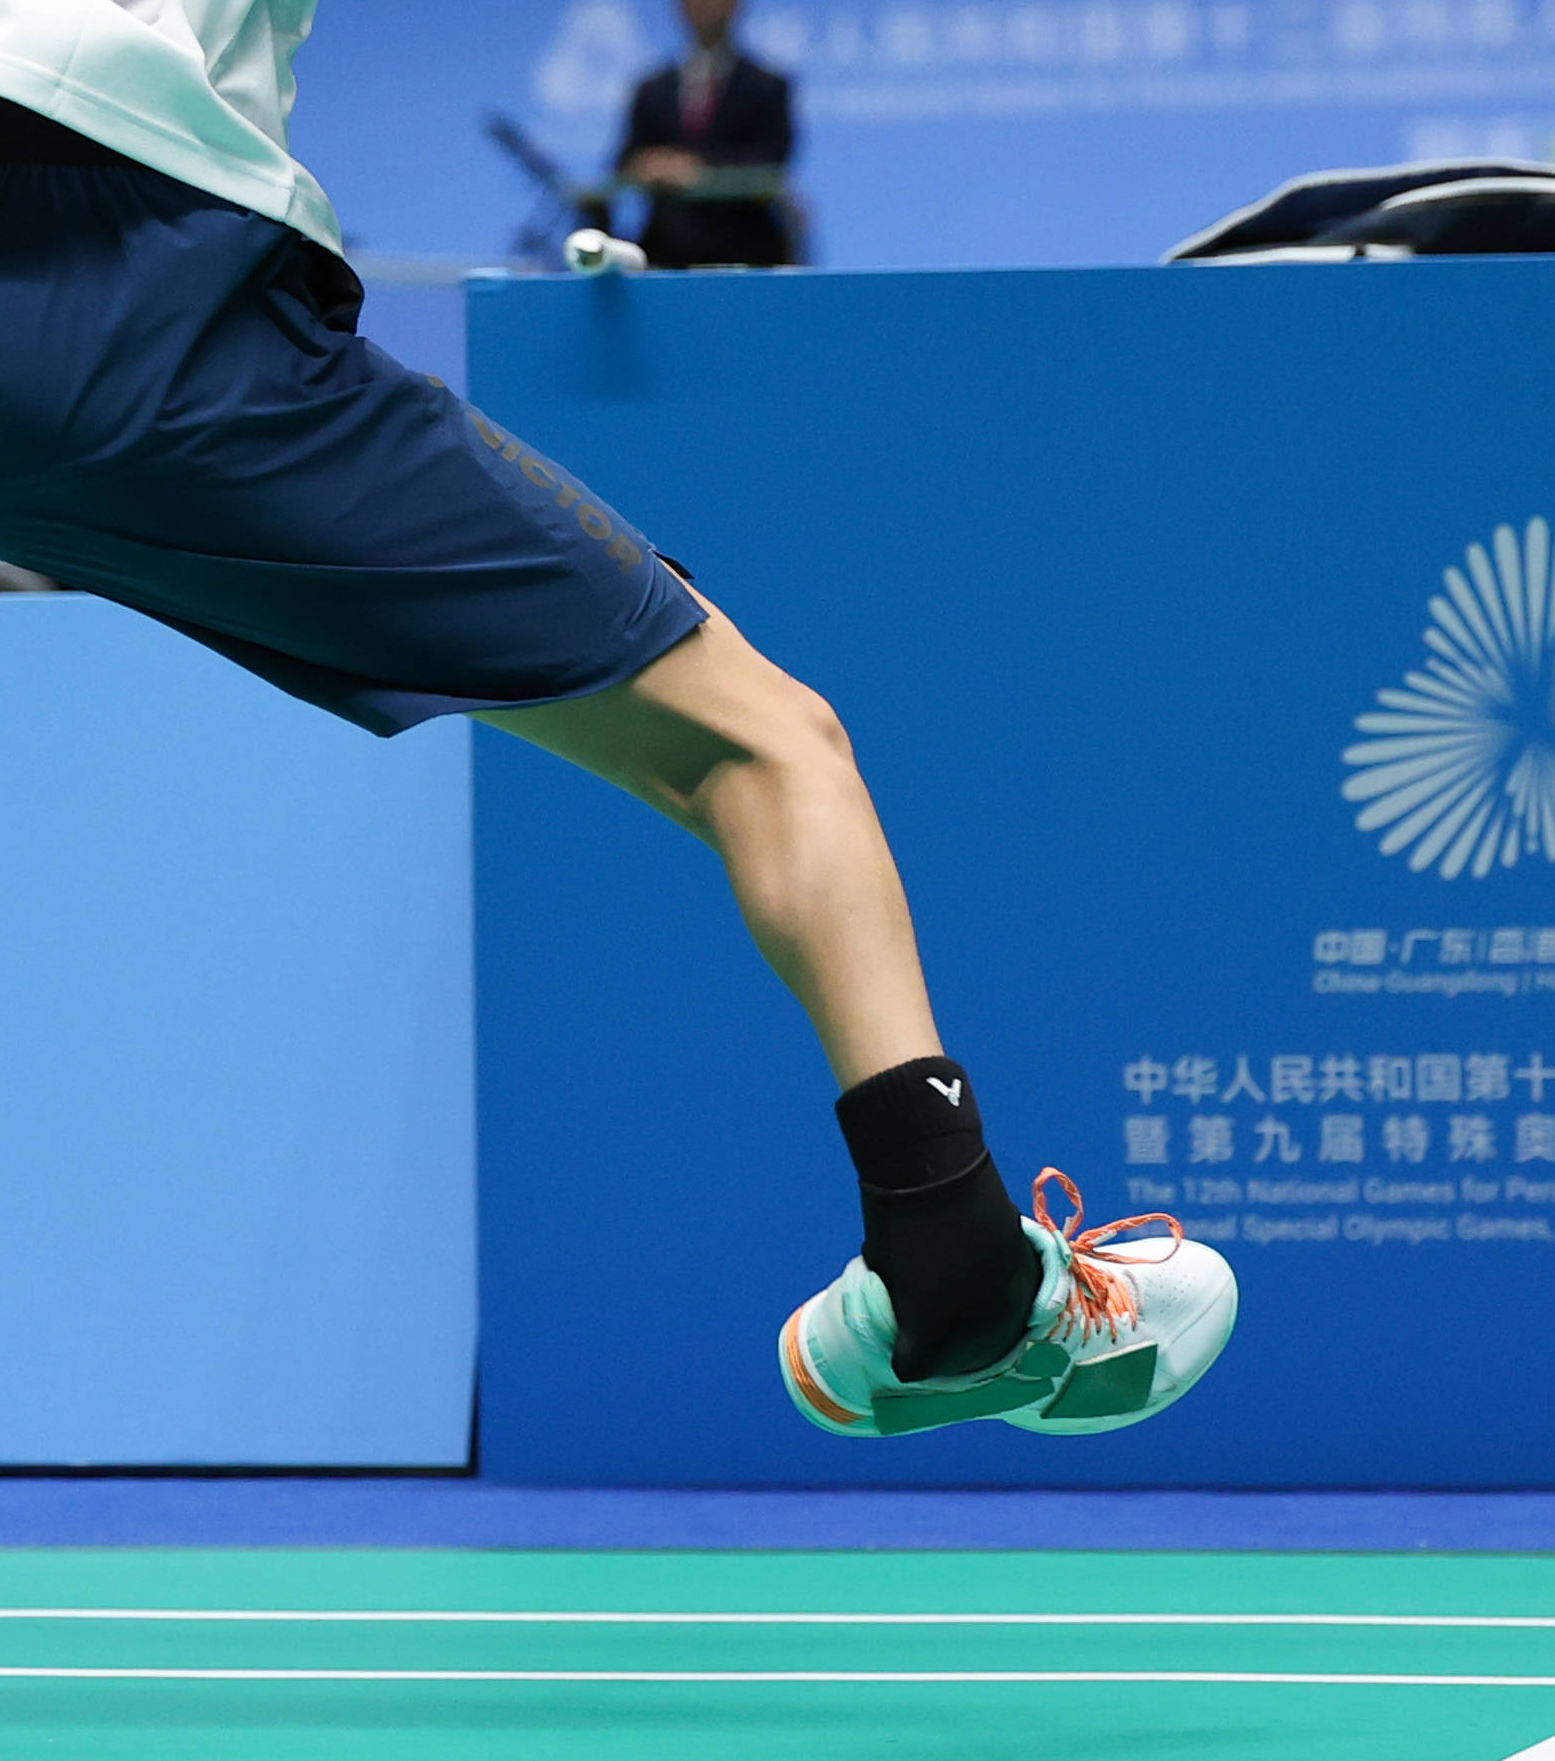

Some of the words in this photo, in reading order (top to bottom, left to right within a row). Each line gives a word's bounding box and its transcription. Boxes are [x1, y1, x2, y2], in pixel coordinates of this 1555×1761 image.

[1127, 1178, 1175, 1204] The
[1183, 1177, 1242, 1204] 12th
[1247, 1177, 1359, 1204] National
[1364, 1177, 1455, 1204] Games
[1461, 1176, 1499, 1203] for
